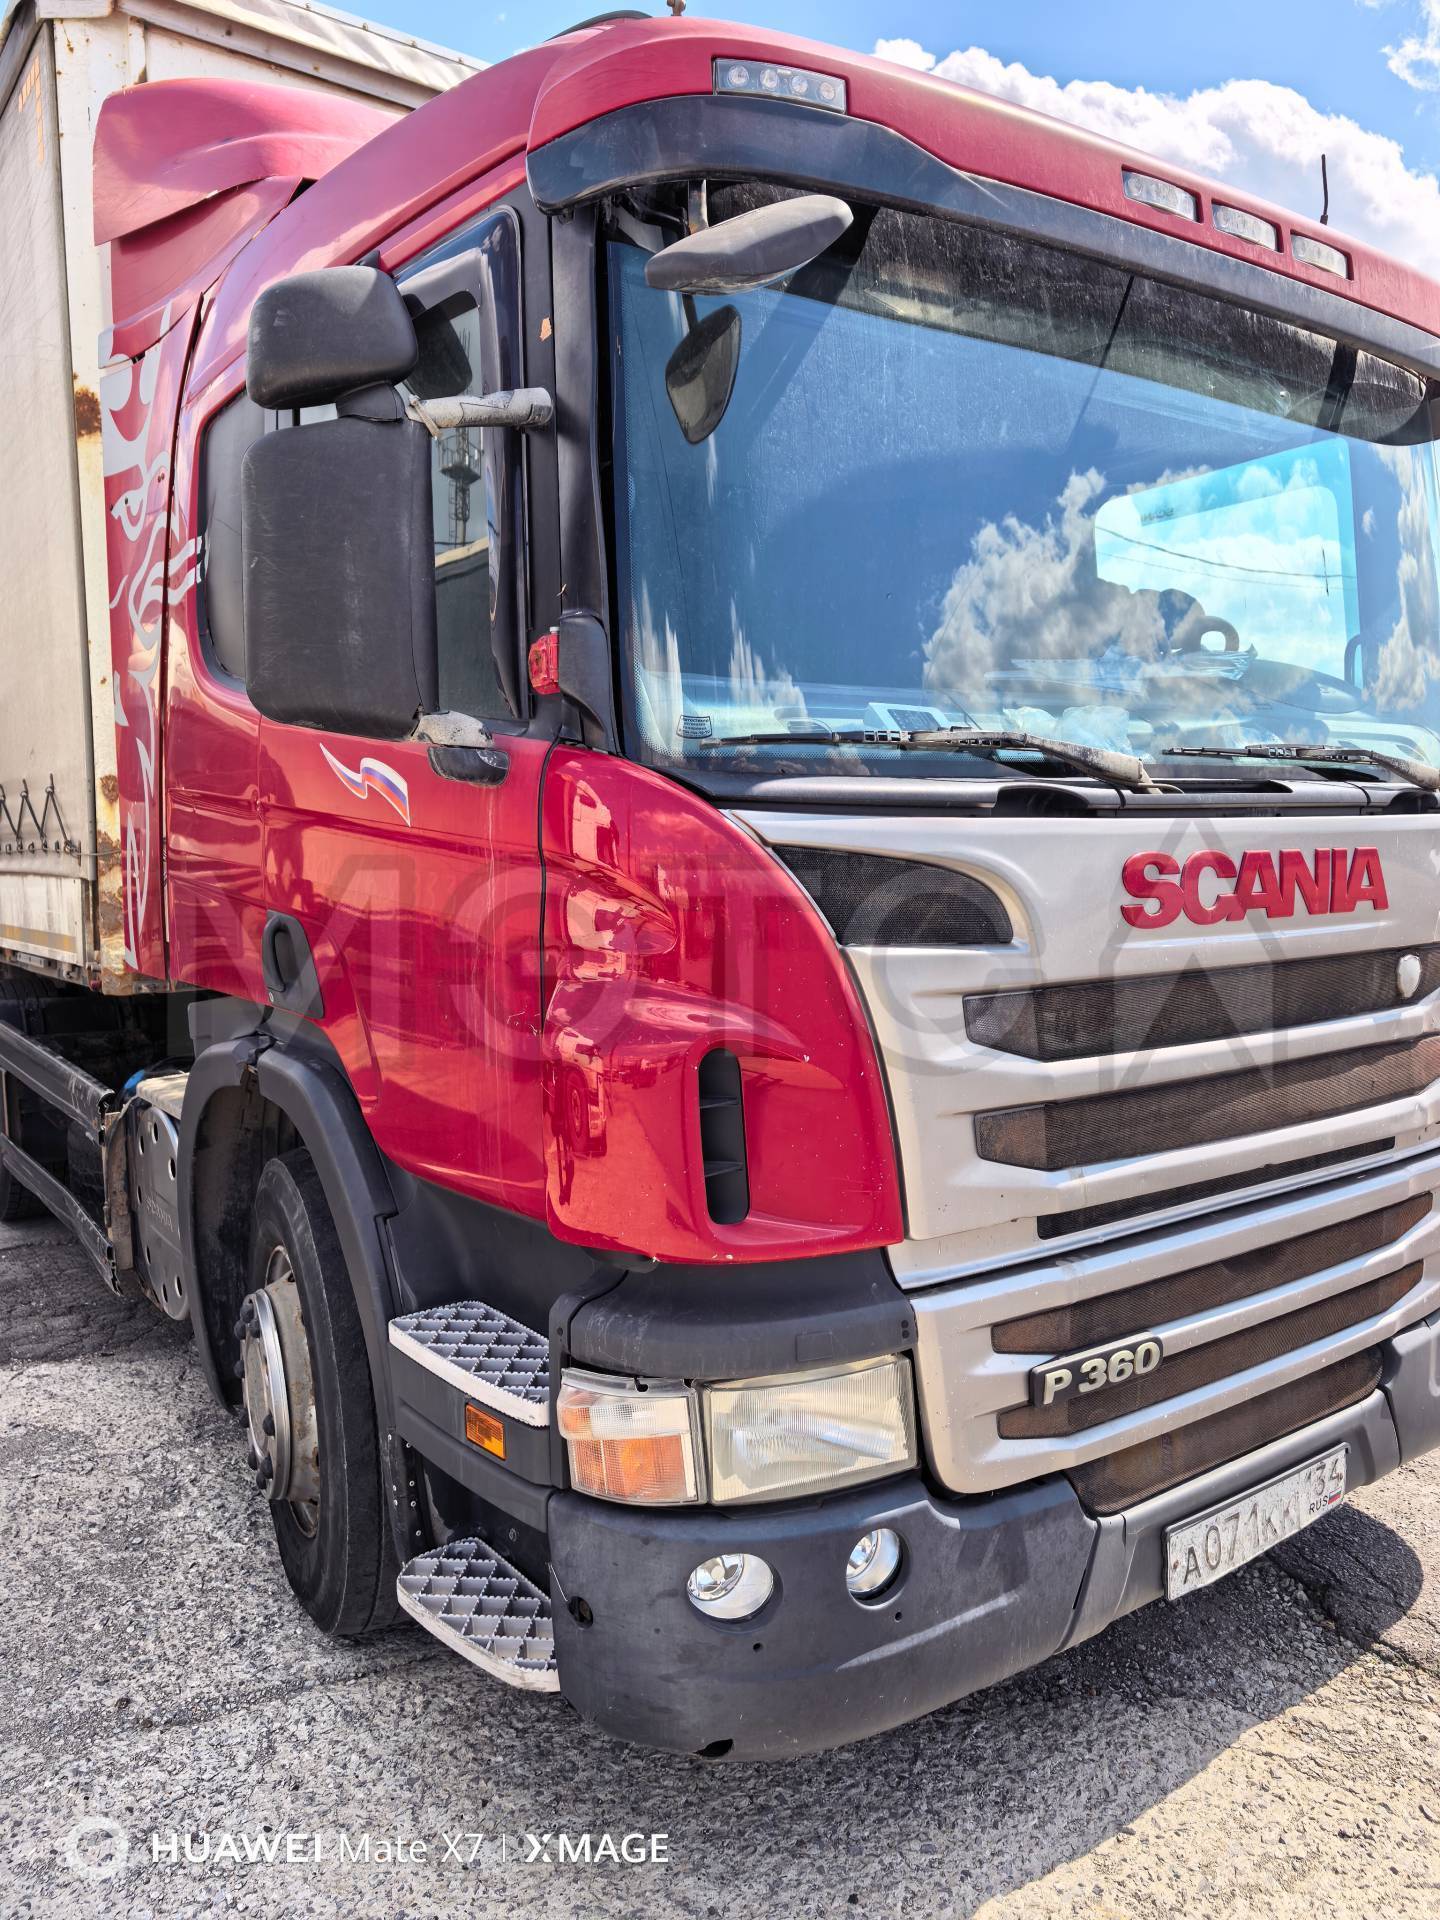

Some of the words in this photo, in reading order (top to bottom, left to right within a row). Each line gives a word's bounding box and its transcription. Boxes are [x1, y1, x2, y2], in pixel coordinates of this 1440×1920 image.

[1120, 846, 1389, 929] SCANIA
[1043, 1368, 1073, 1405] P
[1078, 1341, 1161, 1392] 360
[1309, 1495, 1328, 1515] RUS
